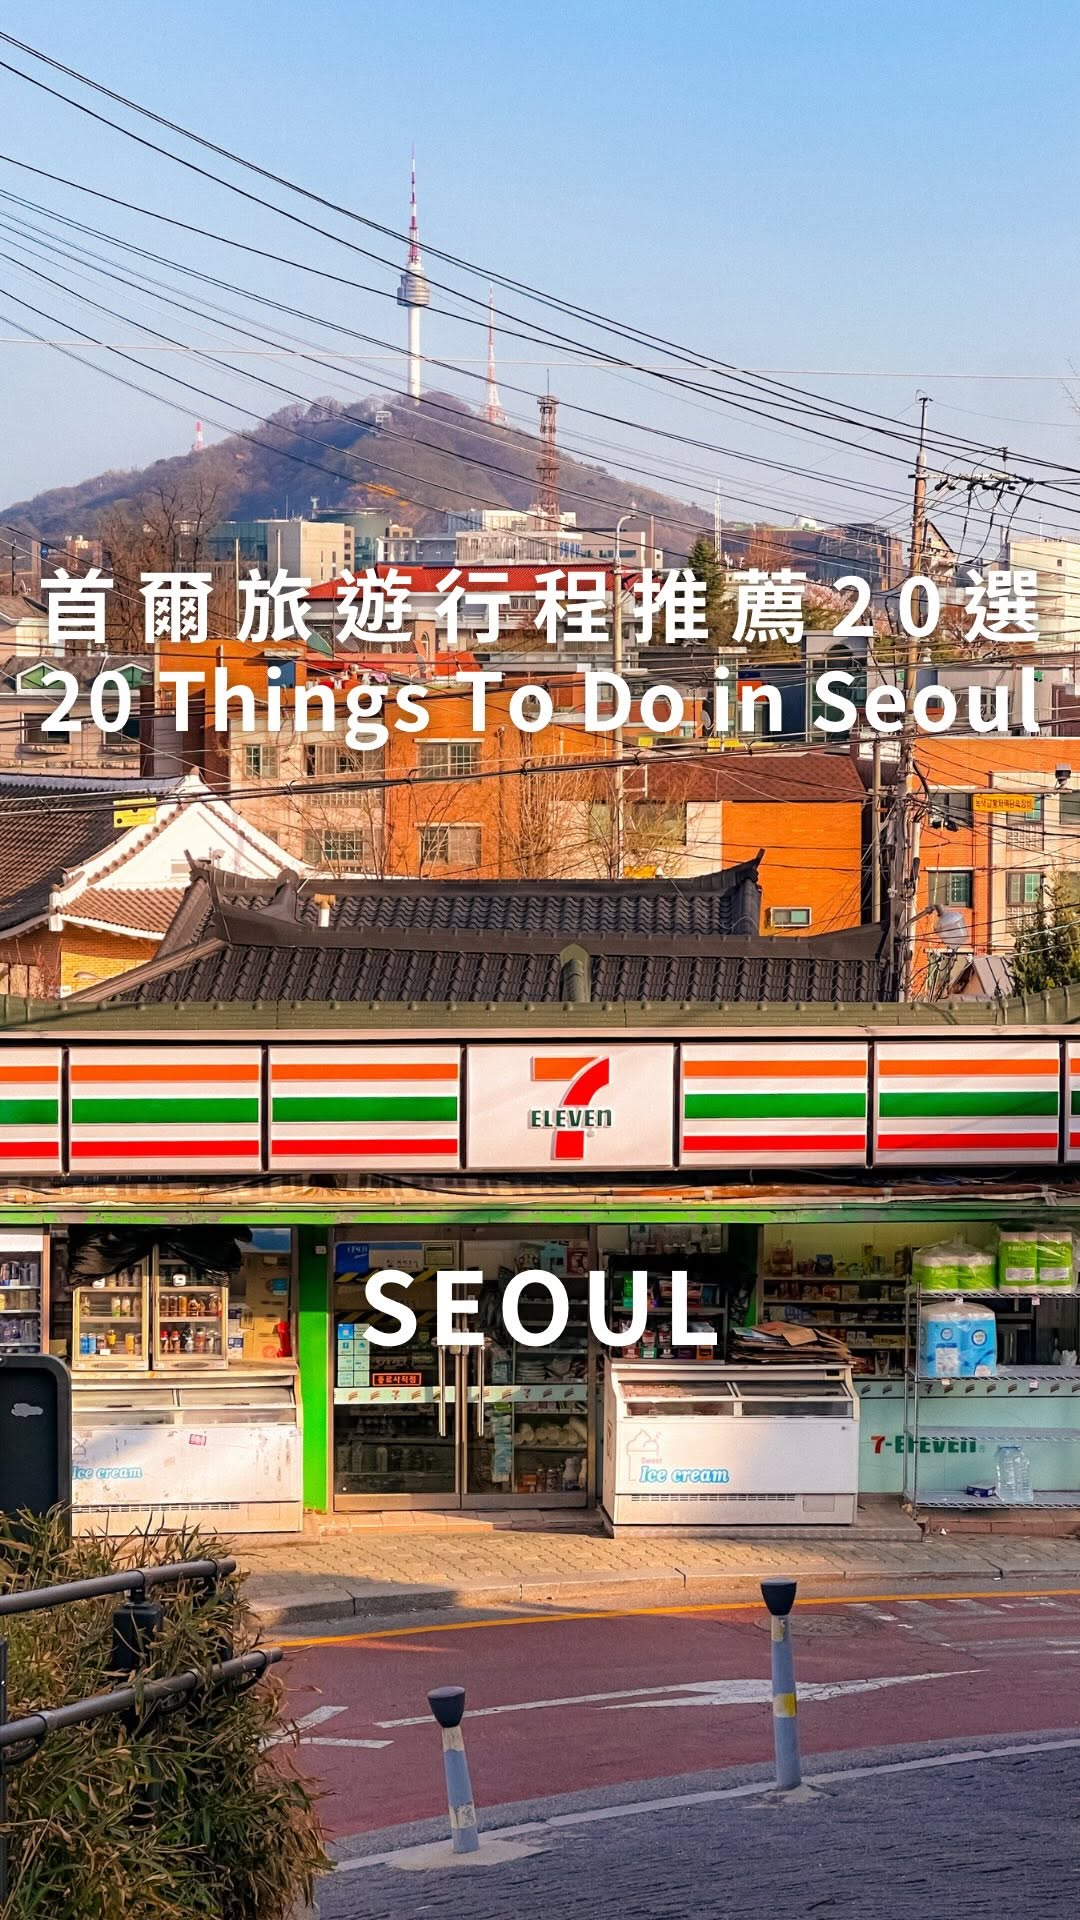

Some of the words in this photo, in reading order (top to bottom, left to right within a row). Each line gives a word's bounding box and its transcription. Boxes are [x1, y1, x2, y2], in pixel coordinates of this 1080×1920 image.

[534, 1056, 610, 1159] 7
[377, 1375, 417, 1385] 종로사직점
[72, 1465, 93, 1480] Ice
[96, 1467, 143, 1480] cream
[639, 1465, 667, 1483] Ice
[671, 1468, 729, 1483] cream
